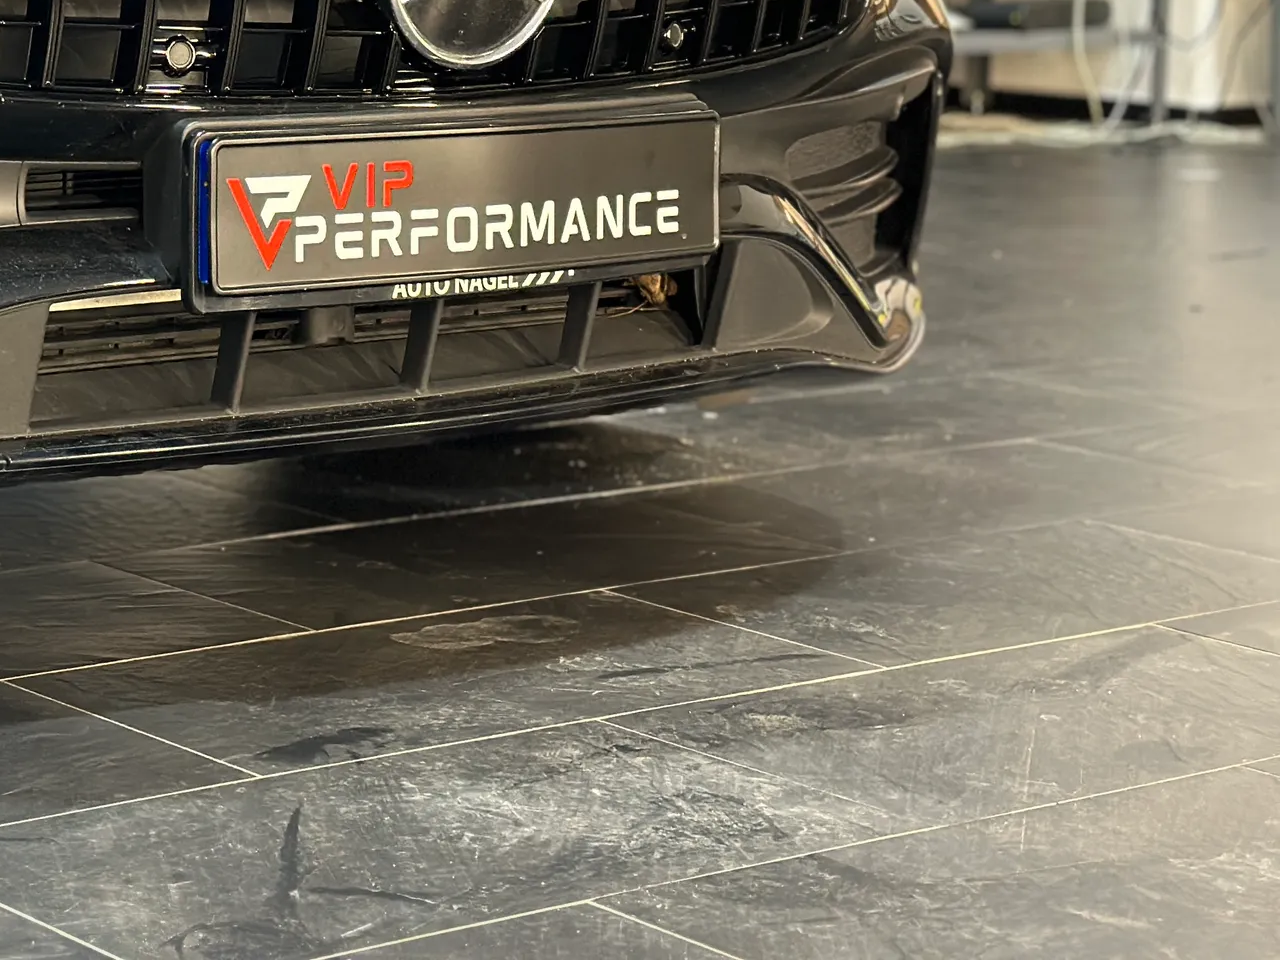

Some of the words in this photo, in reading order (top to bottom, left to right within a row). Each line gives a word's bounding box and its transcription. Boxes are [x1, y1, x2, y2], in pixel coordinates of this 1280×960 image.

[323, 159, 415, 211] VIP
[295, 189, 679, 263] PERFORMANCE
[391, 281, 452, 299] AUTO
[454, 276, 519, 294] NAGEL
